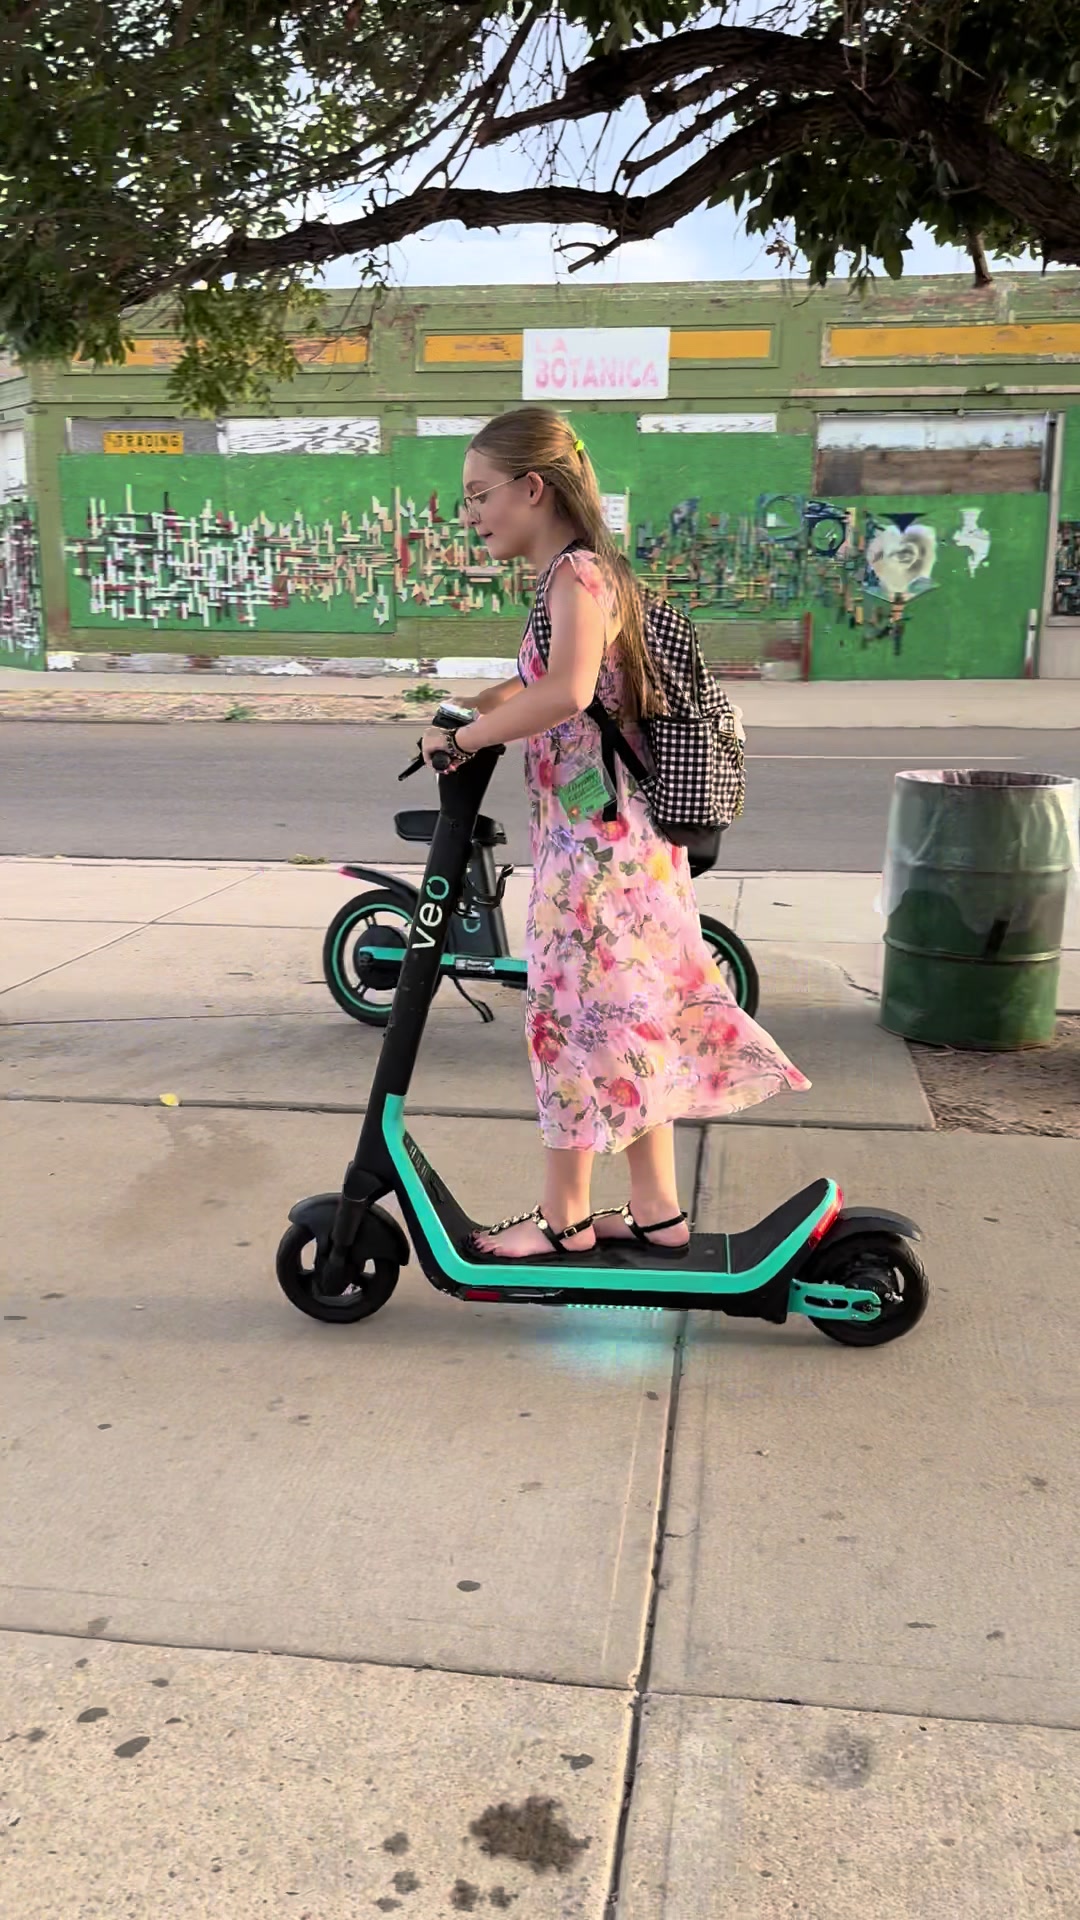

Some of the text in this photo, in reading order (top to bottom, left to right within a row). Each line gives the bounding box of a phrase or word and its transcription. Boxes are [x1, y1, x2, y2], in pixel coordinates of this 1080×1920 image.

[534, 335, 568, 354] LA
[534, 354, 659, 389] BOTANICA
[113, 434, 180, 447] TRADING
[411, 875, 450, 949] veo
